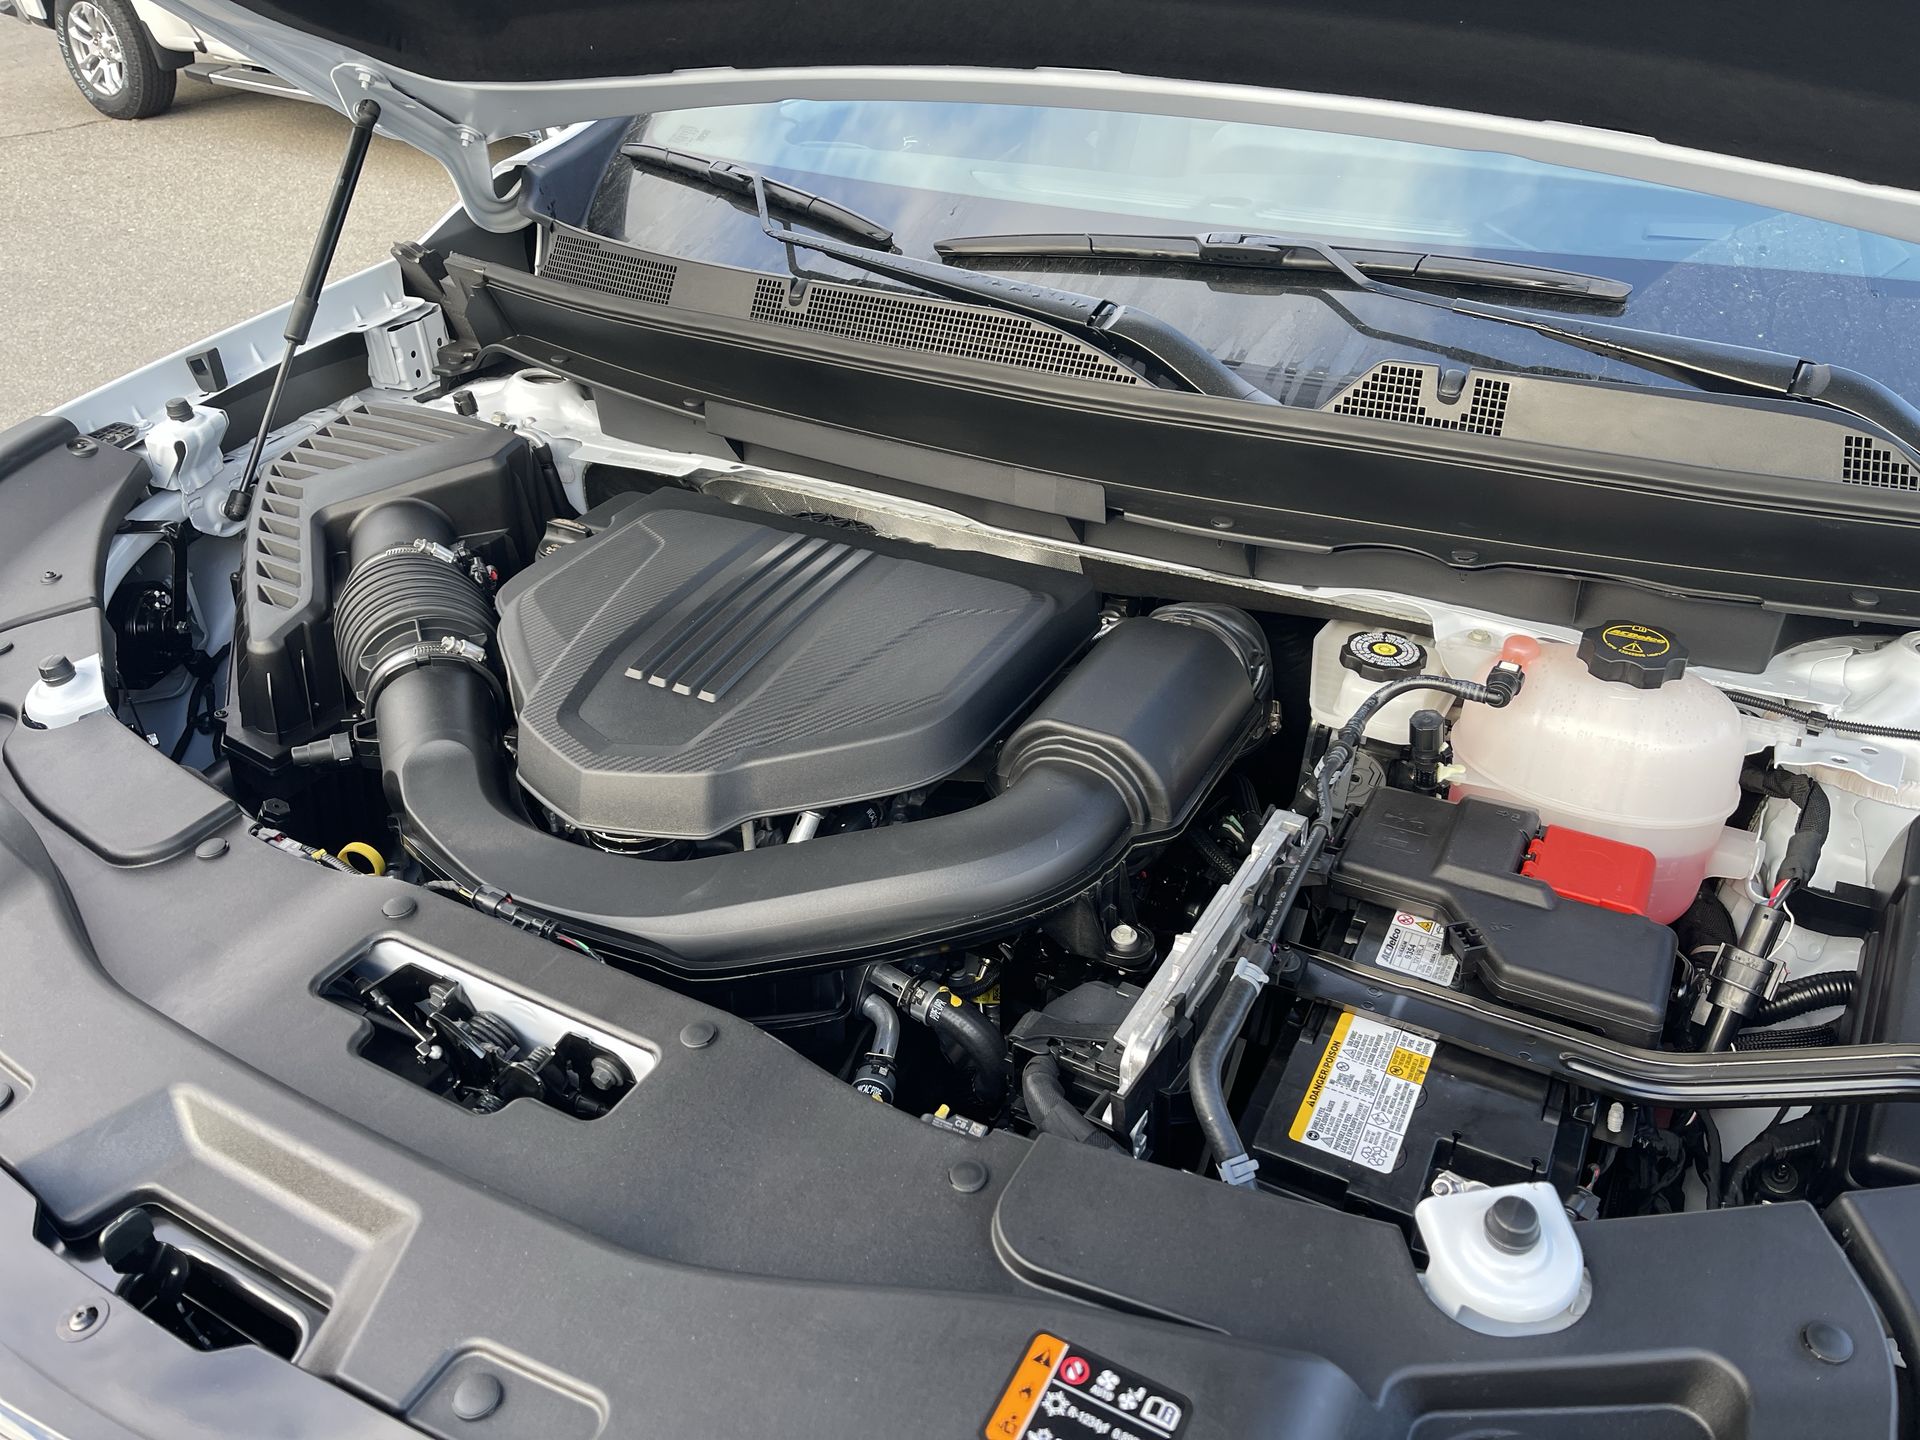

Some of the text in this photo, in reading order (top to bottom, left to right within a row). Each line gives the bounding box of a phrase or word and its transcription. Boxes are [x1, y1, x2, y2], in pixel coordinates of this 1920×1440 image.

[1382, 928, 1401, 962] ACDelco
[1404, 944, 1416, 959] 9354
[1309, 1040, 1340, 1100] DANGER/POISON
